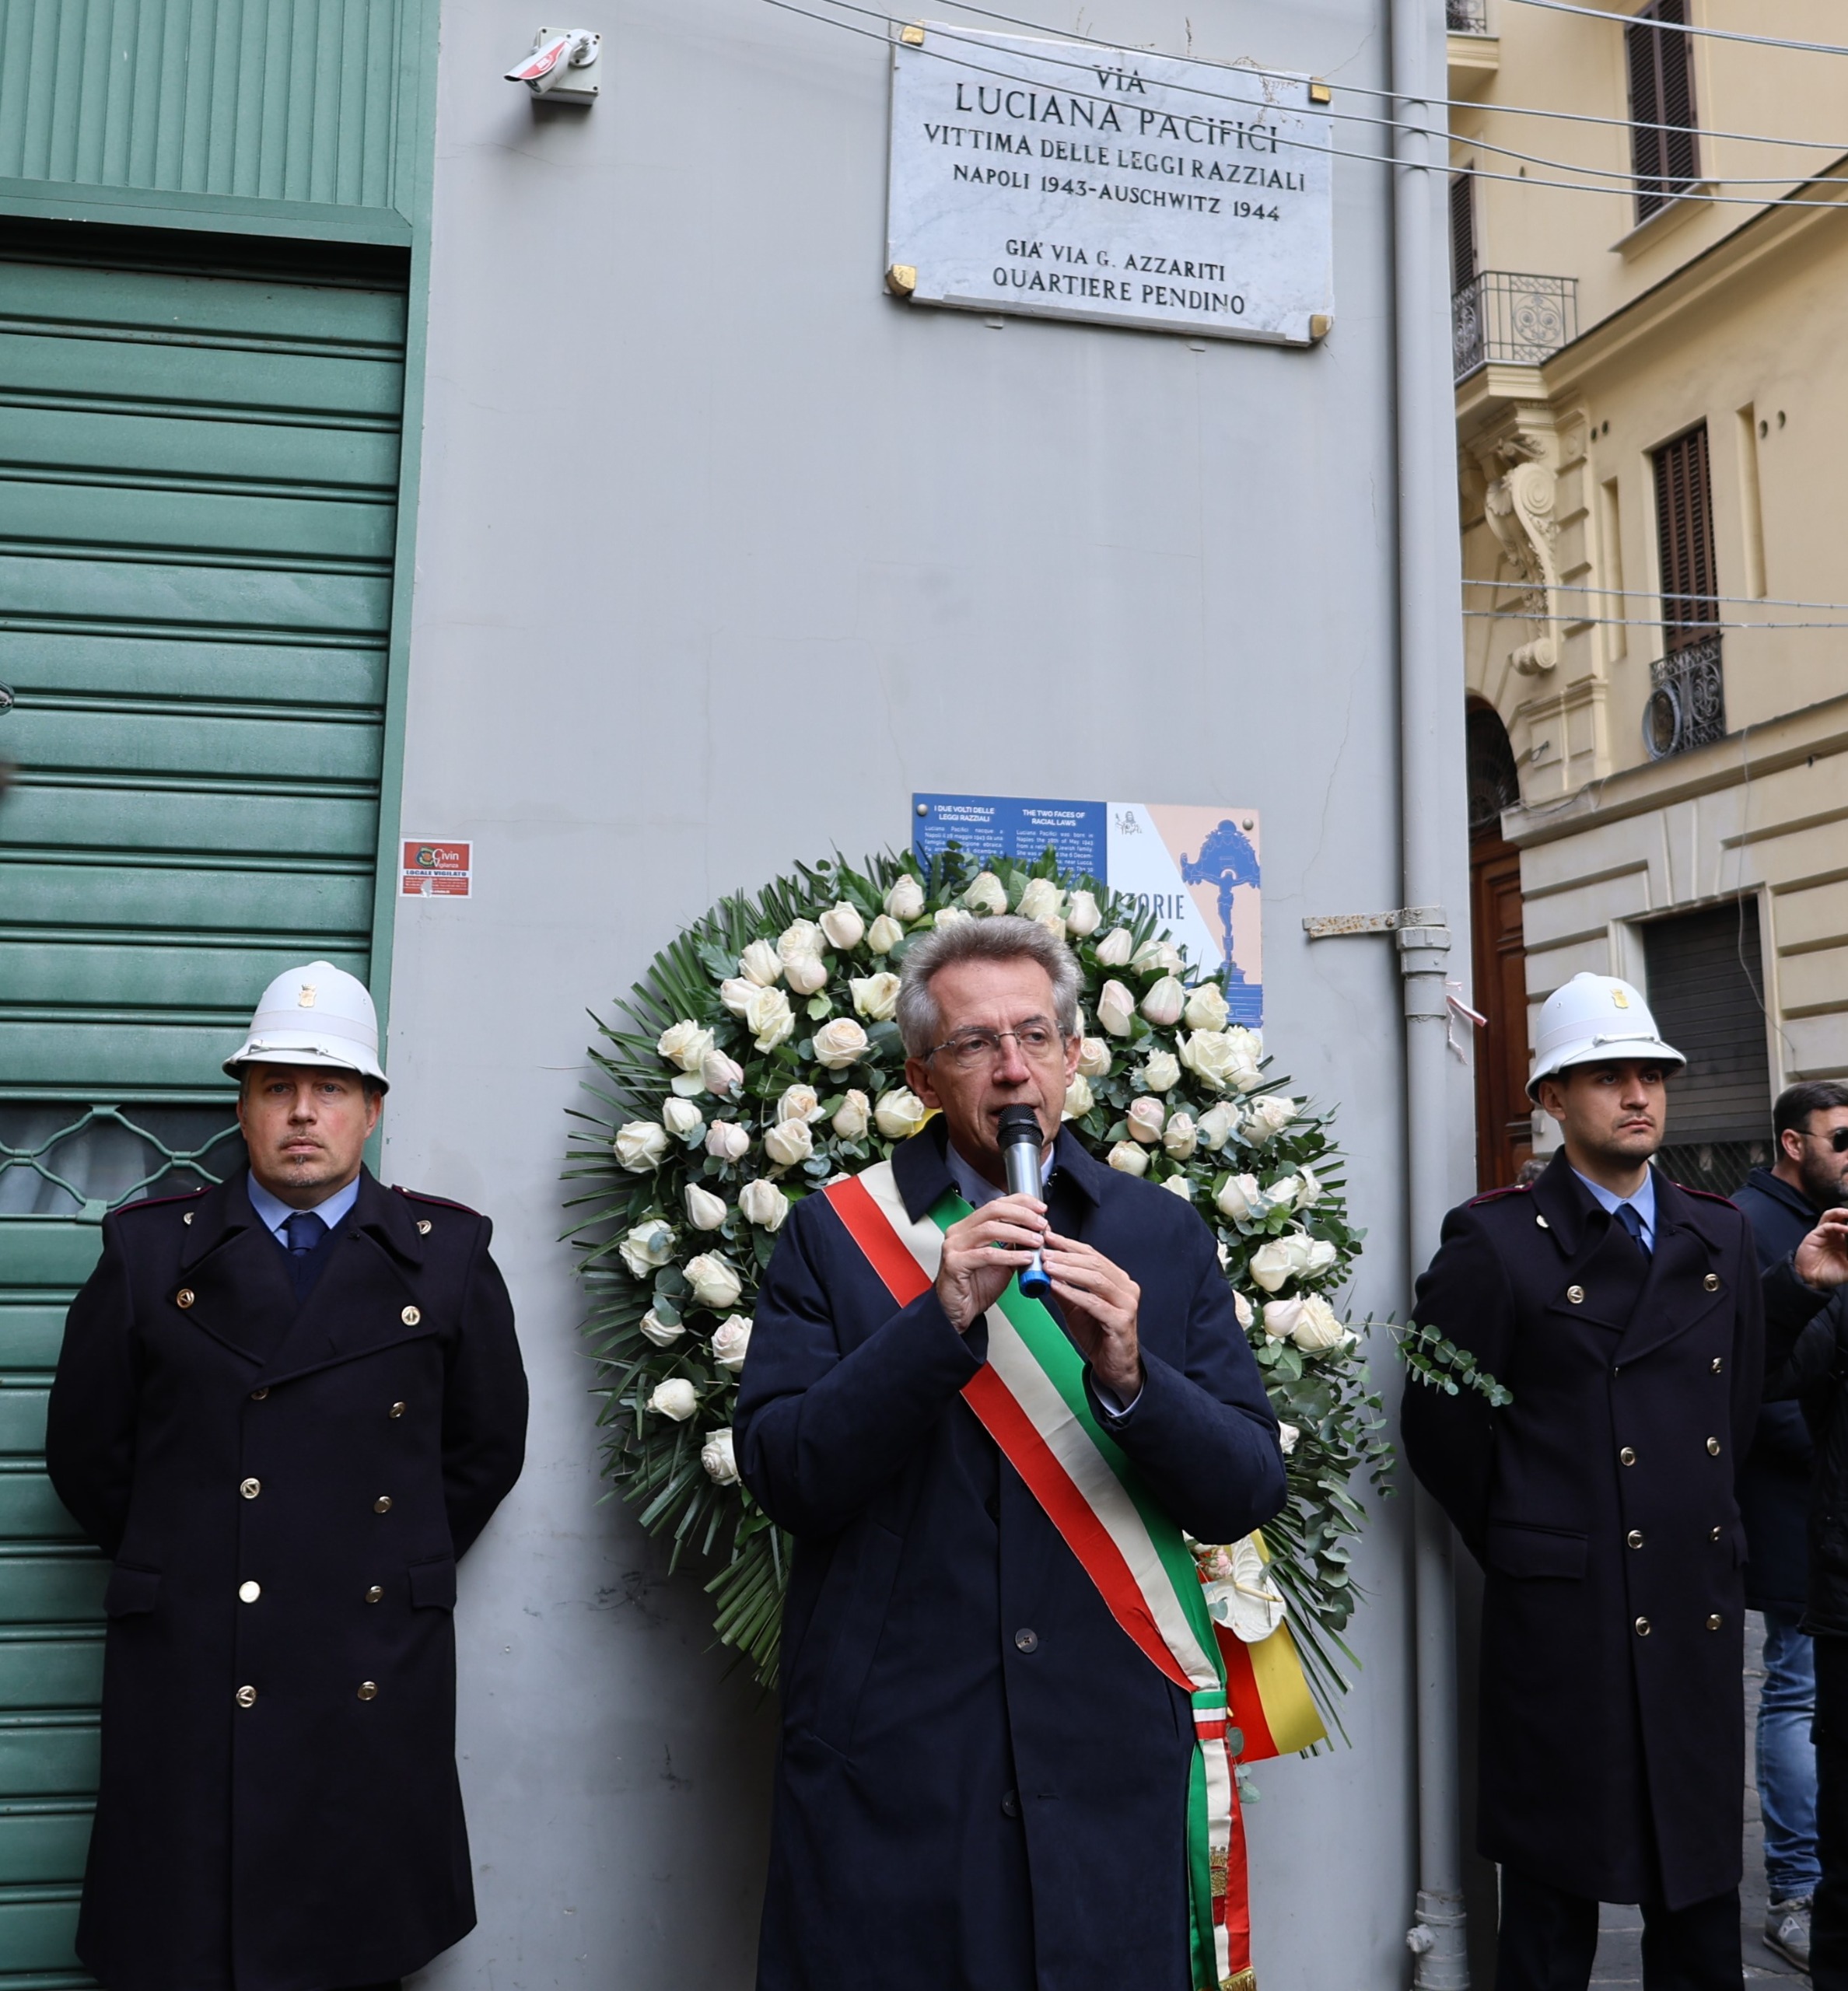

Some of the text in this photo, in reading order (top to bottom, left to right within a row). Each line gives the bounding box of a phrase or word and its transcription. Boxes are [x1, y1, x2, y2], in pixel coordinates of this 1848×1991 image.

[1092, 65, 1147, 94] VIA
[956, 83, 1278, 154] LUCIANA PACIFICI
[923, 124, 1305, 191] VITTIMA DELLE LEGGI RAZZIALI
[954, 164, 1280, 222] NAPOLI 1943-AUSCHWITZ 1944
[1052, 245, 1088, 264] VIA
[1097, 251, 1115, 268] G.
[1124, 254, 1225, 282] AZZARITI
[993, 267, 1244, 315] QUARTIERE PENDINO
[432, 849, 459, 860] Civin
